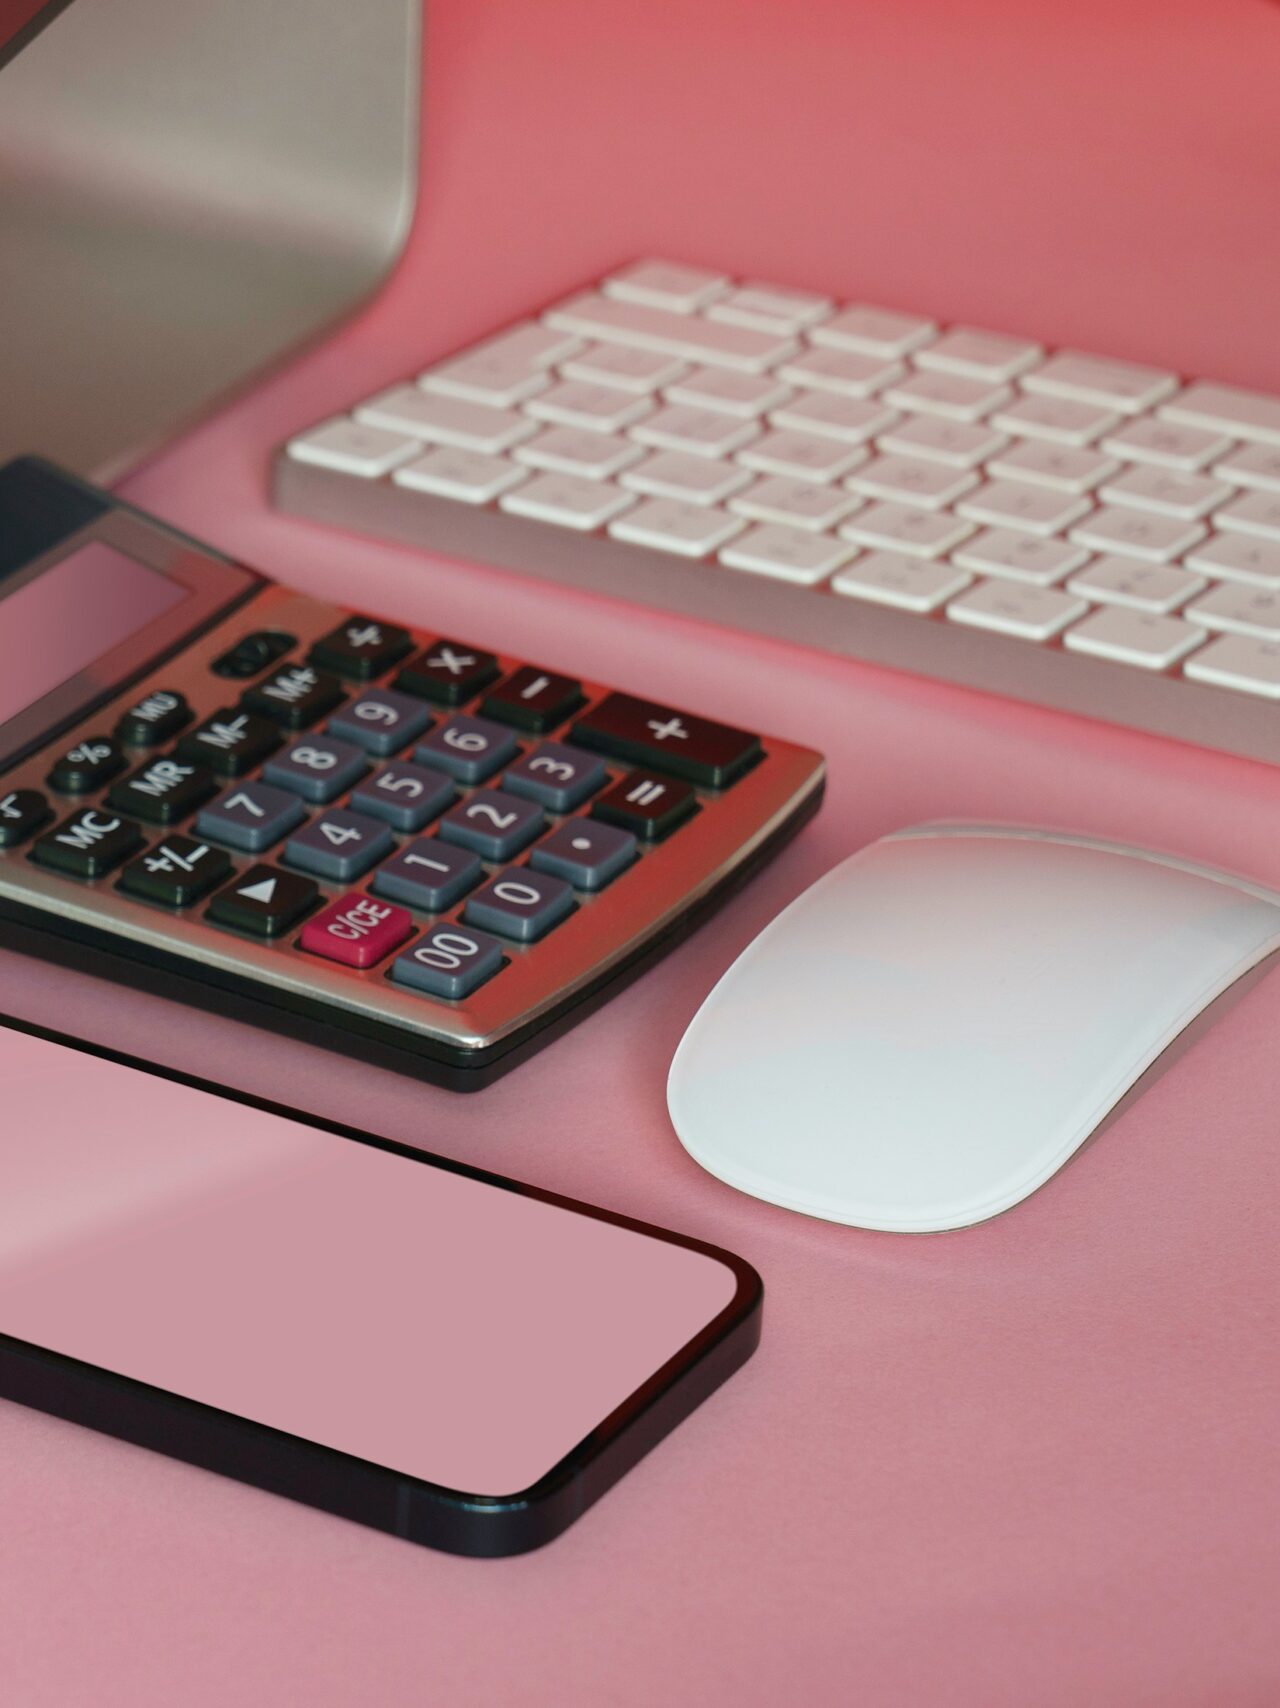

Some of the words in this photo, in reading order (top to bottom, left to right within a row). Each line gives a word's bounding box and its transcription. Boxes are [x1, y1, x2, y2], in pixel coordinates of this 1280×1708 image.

[355, 703, 398, 724] 9
[66, 737, 111, 765] %
[444, 728, 487, 751] 6
[291, 747, 336, 769] 8
[530, 758, 574, 780] 3
[130, 761, 193, 796] MR
[378, 773, 423, 797] 5
[225, 794, 264, 816] 7
[467, 805, 516, 828] 2
[56, 812, 120, 848] MC
[320, 823, 361, 844] 4
[405, 854, 449, 872] 1
[494, 883, 540, 904] 0
[328, 900, 391, 939] C/CE
[415, 934, 478, 968] 00
